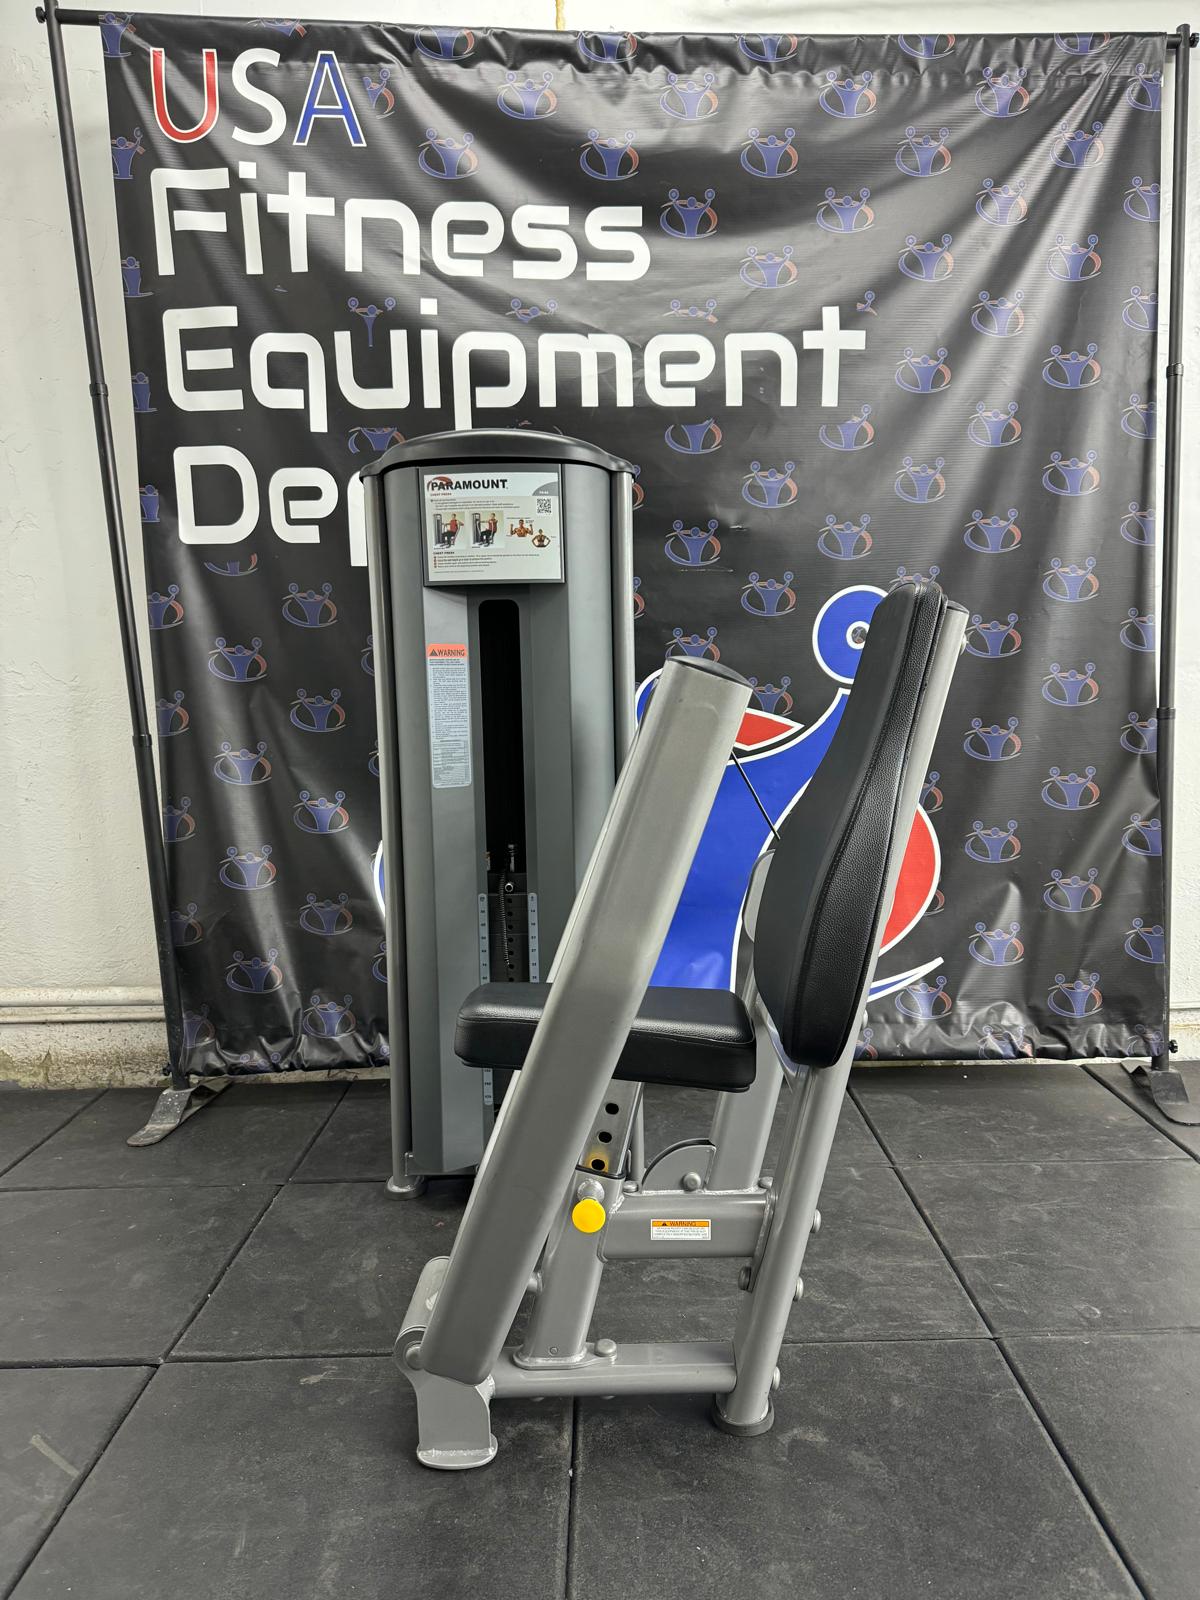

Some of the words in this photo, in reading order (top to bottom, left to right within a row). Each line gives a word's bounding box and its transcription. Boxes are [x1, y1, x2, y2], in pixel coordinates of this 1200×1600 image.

[150, 47, 367, 147] USA
[150, 160, 651, 282] Fitness
[162, 297, 867, 431] Equipment
[431, 479, 508, 491] PARAMOUNT
